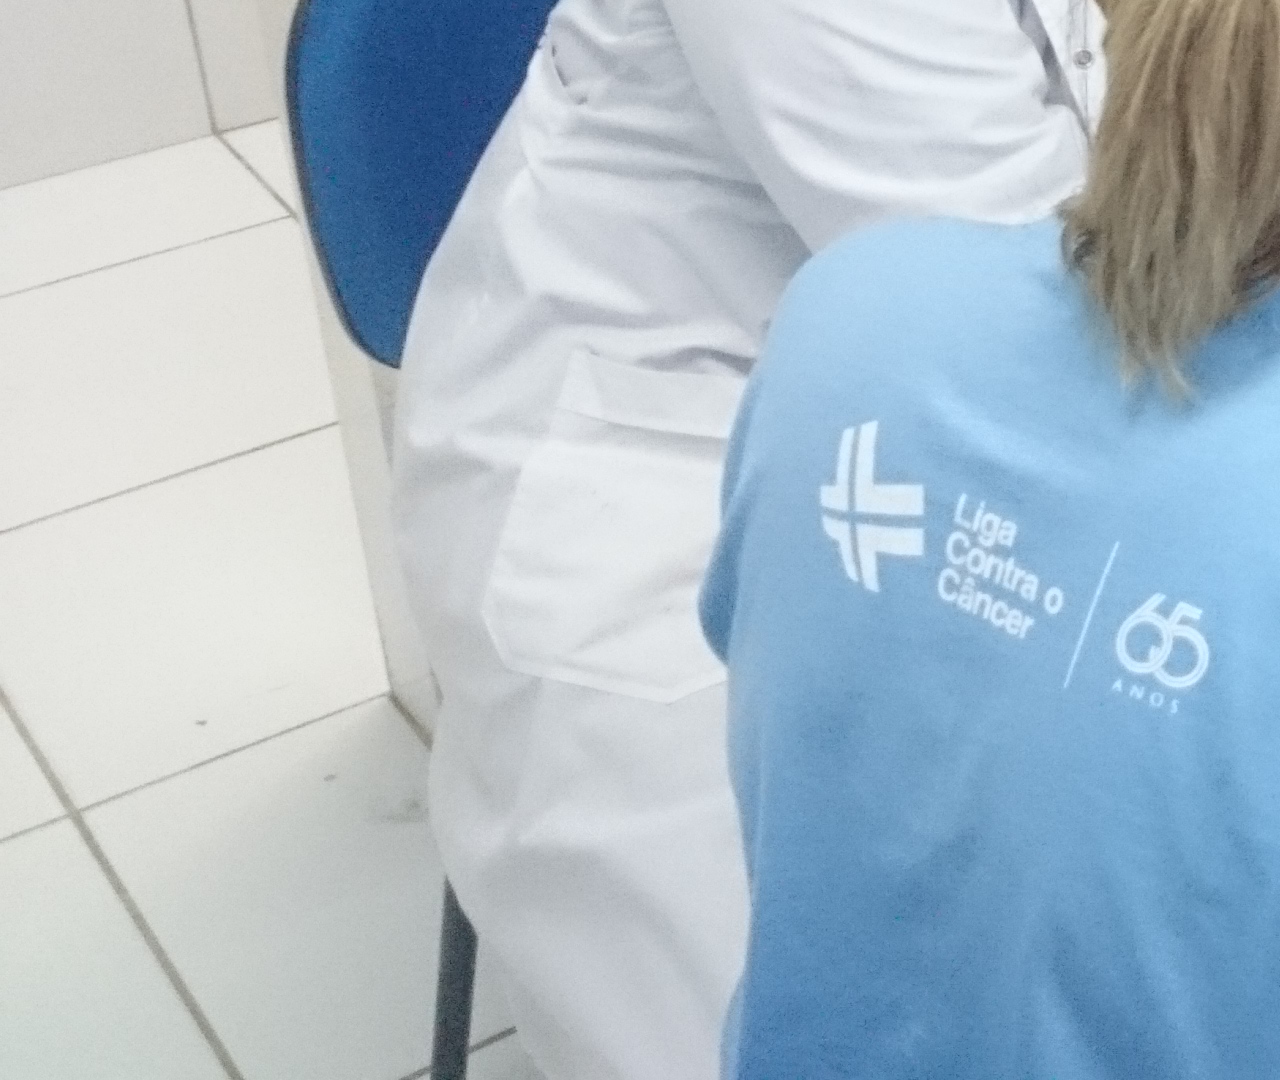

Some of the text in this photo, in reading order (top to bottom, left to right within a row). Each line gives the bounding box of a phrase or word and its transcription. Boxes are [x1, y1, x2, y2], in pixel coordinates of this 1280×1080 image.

[953, 493, 1018, 548] Liga
[936, 567, 1036, 640] Câncer
[945, 530, 1064, 615] Contra o
[1115, 592, 1210, 689] 65
[1111, 677, 1181, 715] ANOS
